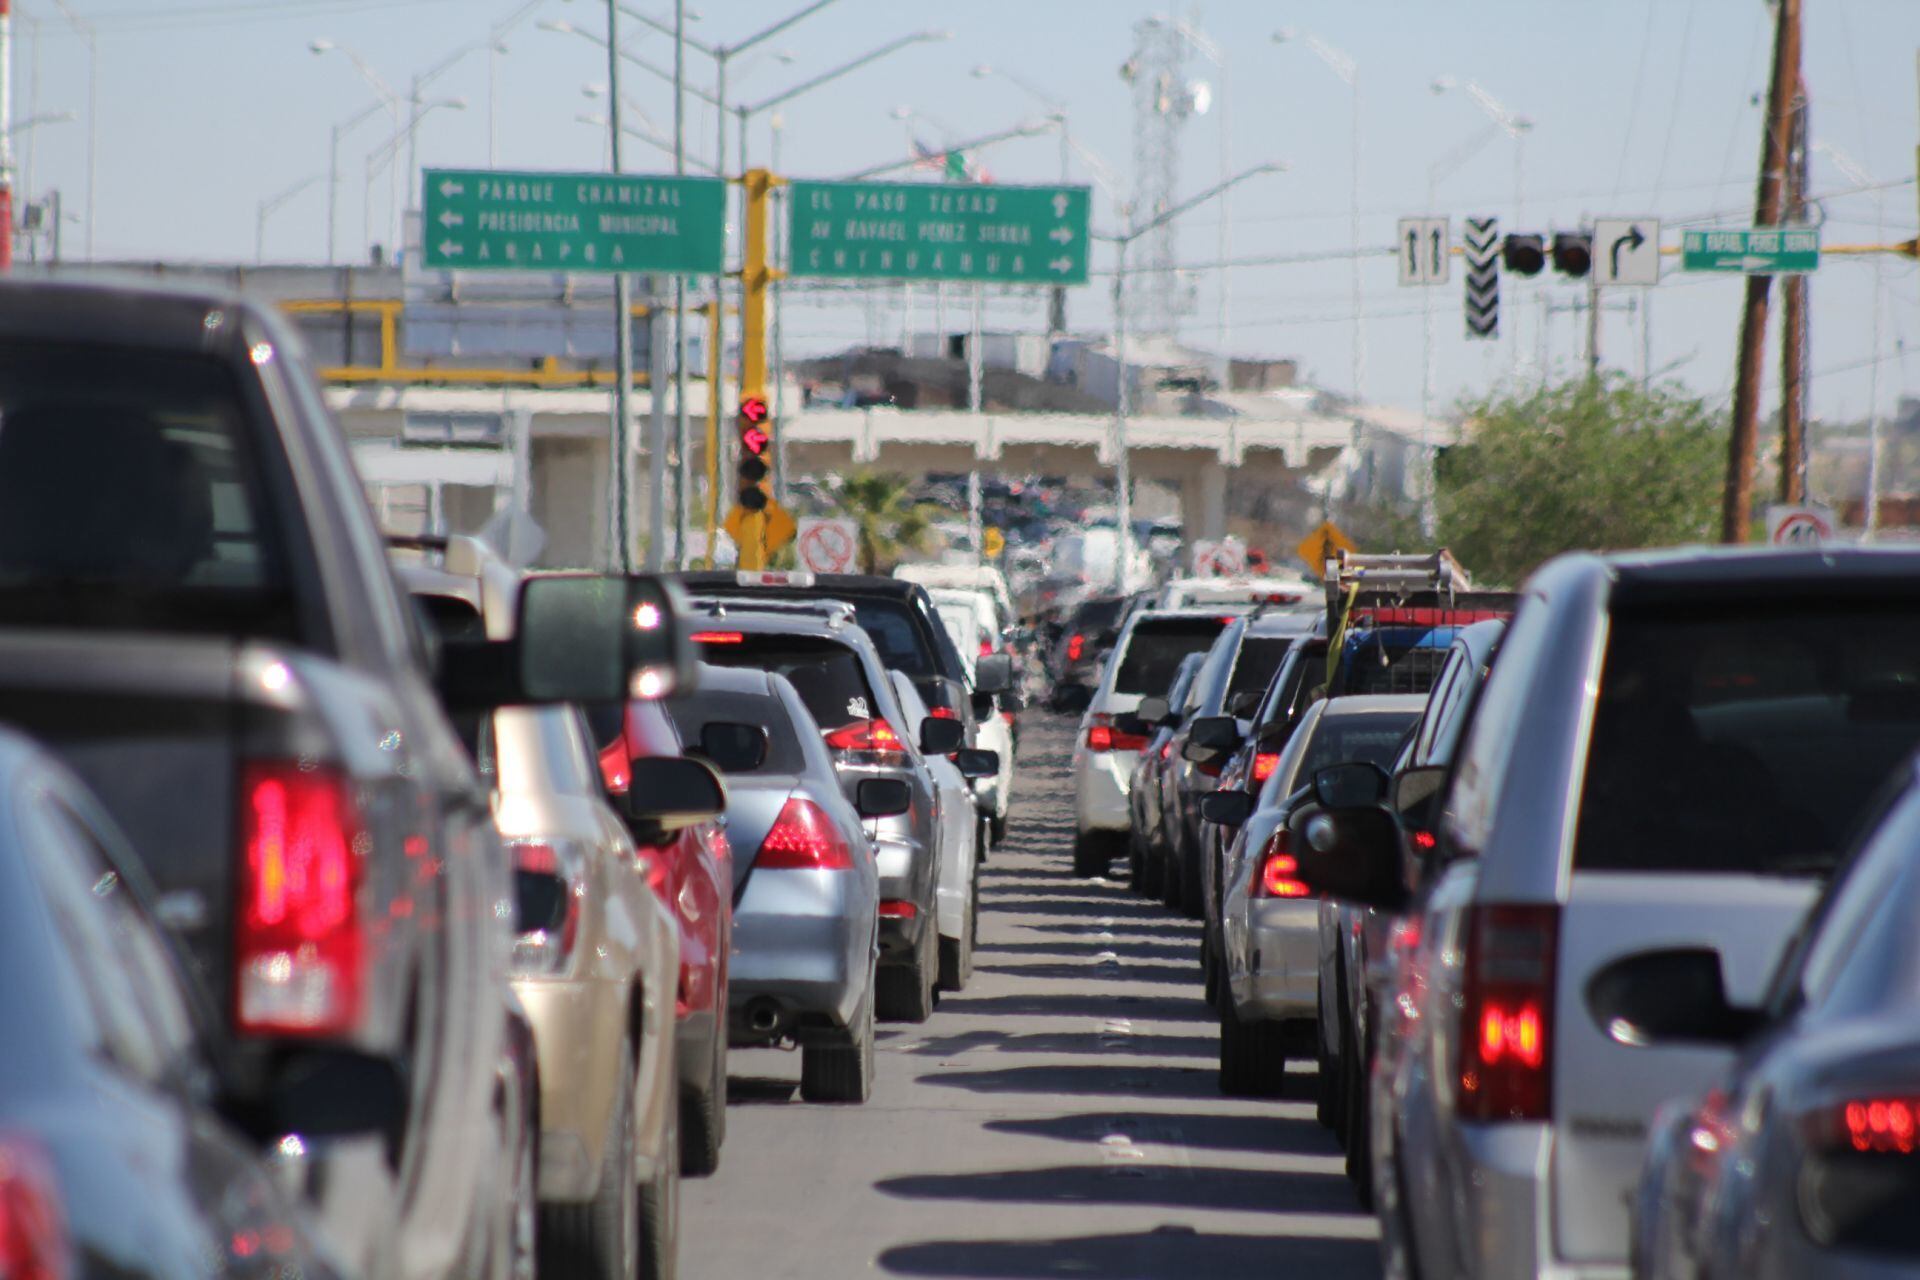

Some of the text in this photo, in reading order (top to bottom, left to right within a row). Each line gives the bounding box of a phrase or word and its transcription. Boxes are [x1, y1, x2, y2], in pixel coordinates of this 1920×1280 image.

[478, 181, 680, 207] PARQUE CHAMIZAL
[811, 190, 997, 214] EL PASO TEXAS
[478, 211, 679, 235] PRESIDENCIA MUNICIPAL
[845, 219, 906, 241] RAFAEL
[918, 221, 965, 242] PEREZ
[1707, 233, 1743, 252] RAFAEL
[1748, 233, 1778, 252] PEREZ
[1783, 233, 1817, 253] SERNA
[811, 249, 1024, 273] CHIHUAHUA
